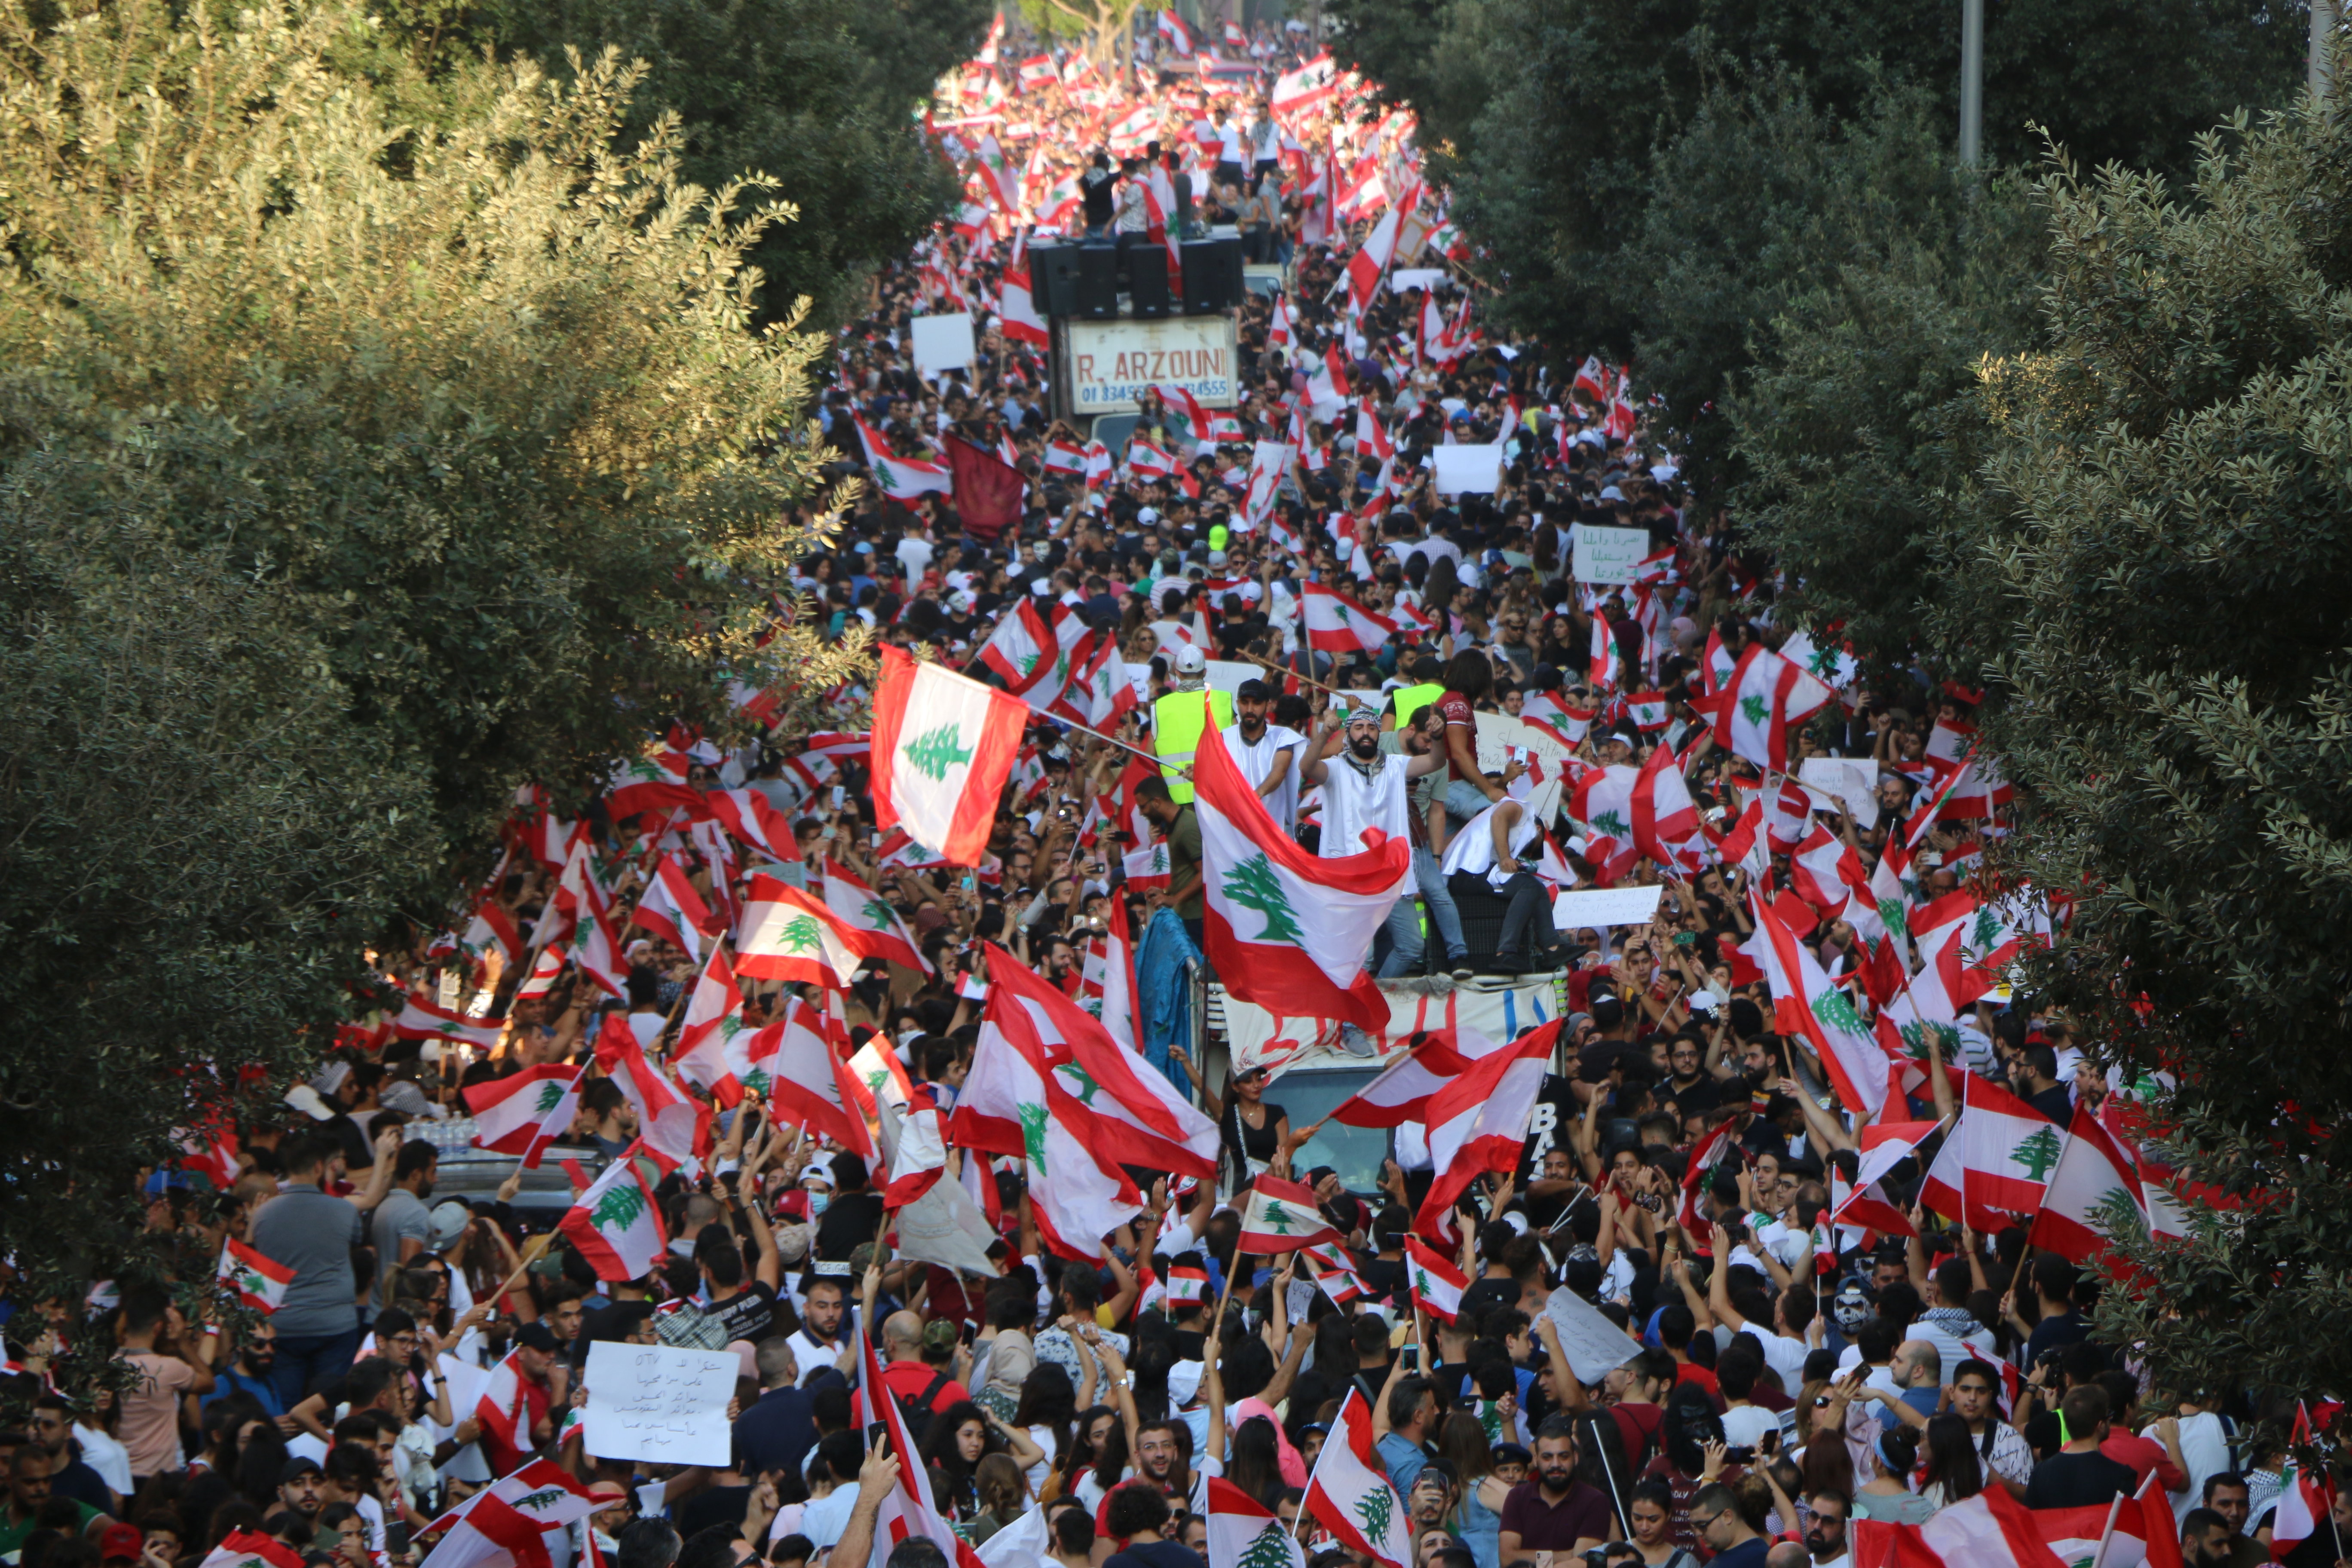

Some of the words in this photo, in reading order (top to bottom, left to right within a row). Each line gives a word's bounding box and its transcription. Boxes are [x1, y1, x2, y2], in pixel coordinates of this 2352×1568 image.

[1114, 347, 1226, 381] ARZOUNI
[1082, 386, 1096, 402] 01
[635, 1353, 661, 1366] OTV
